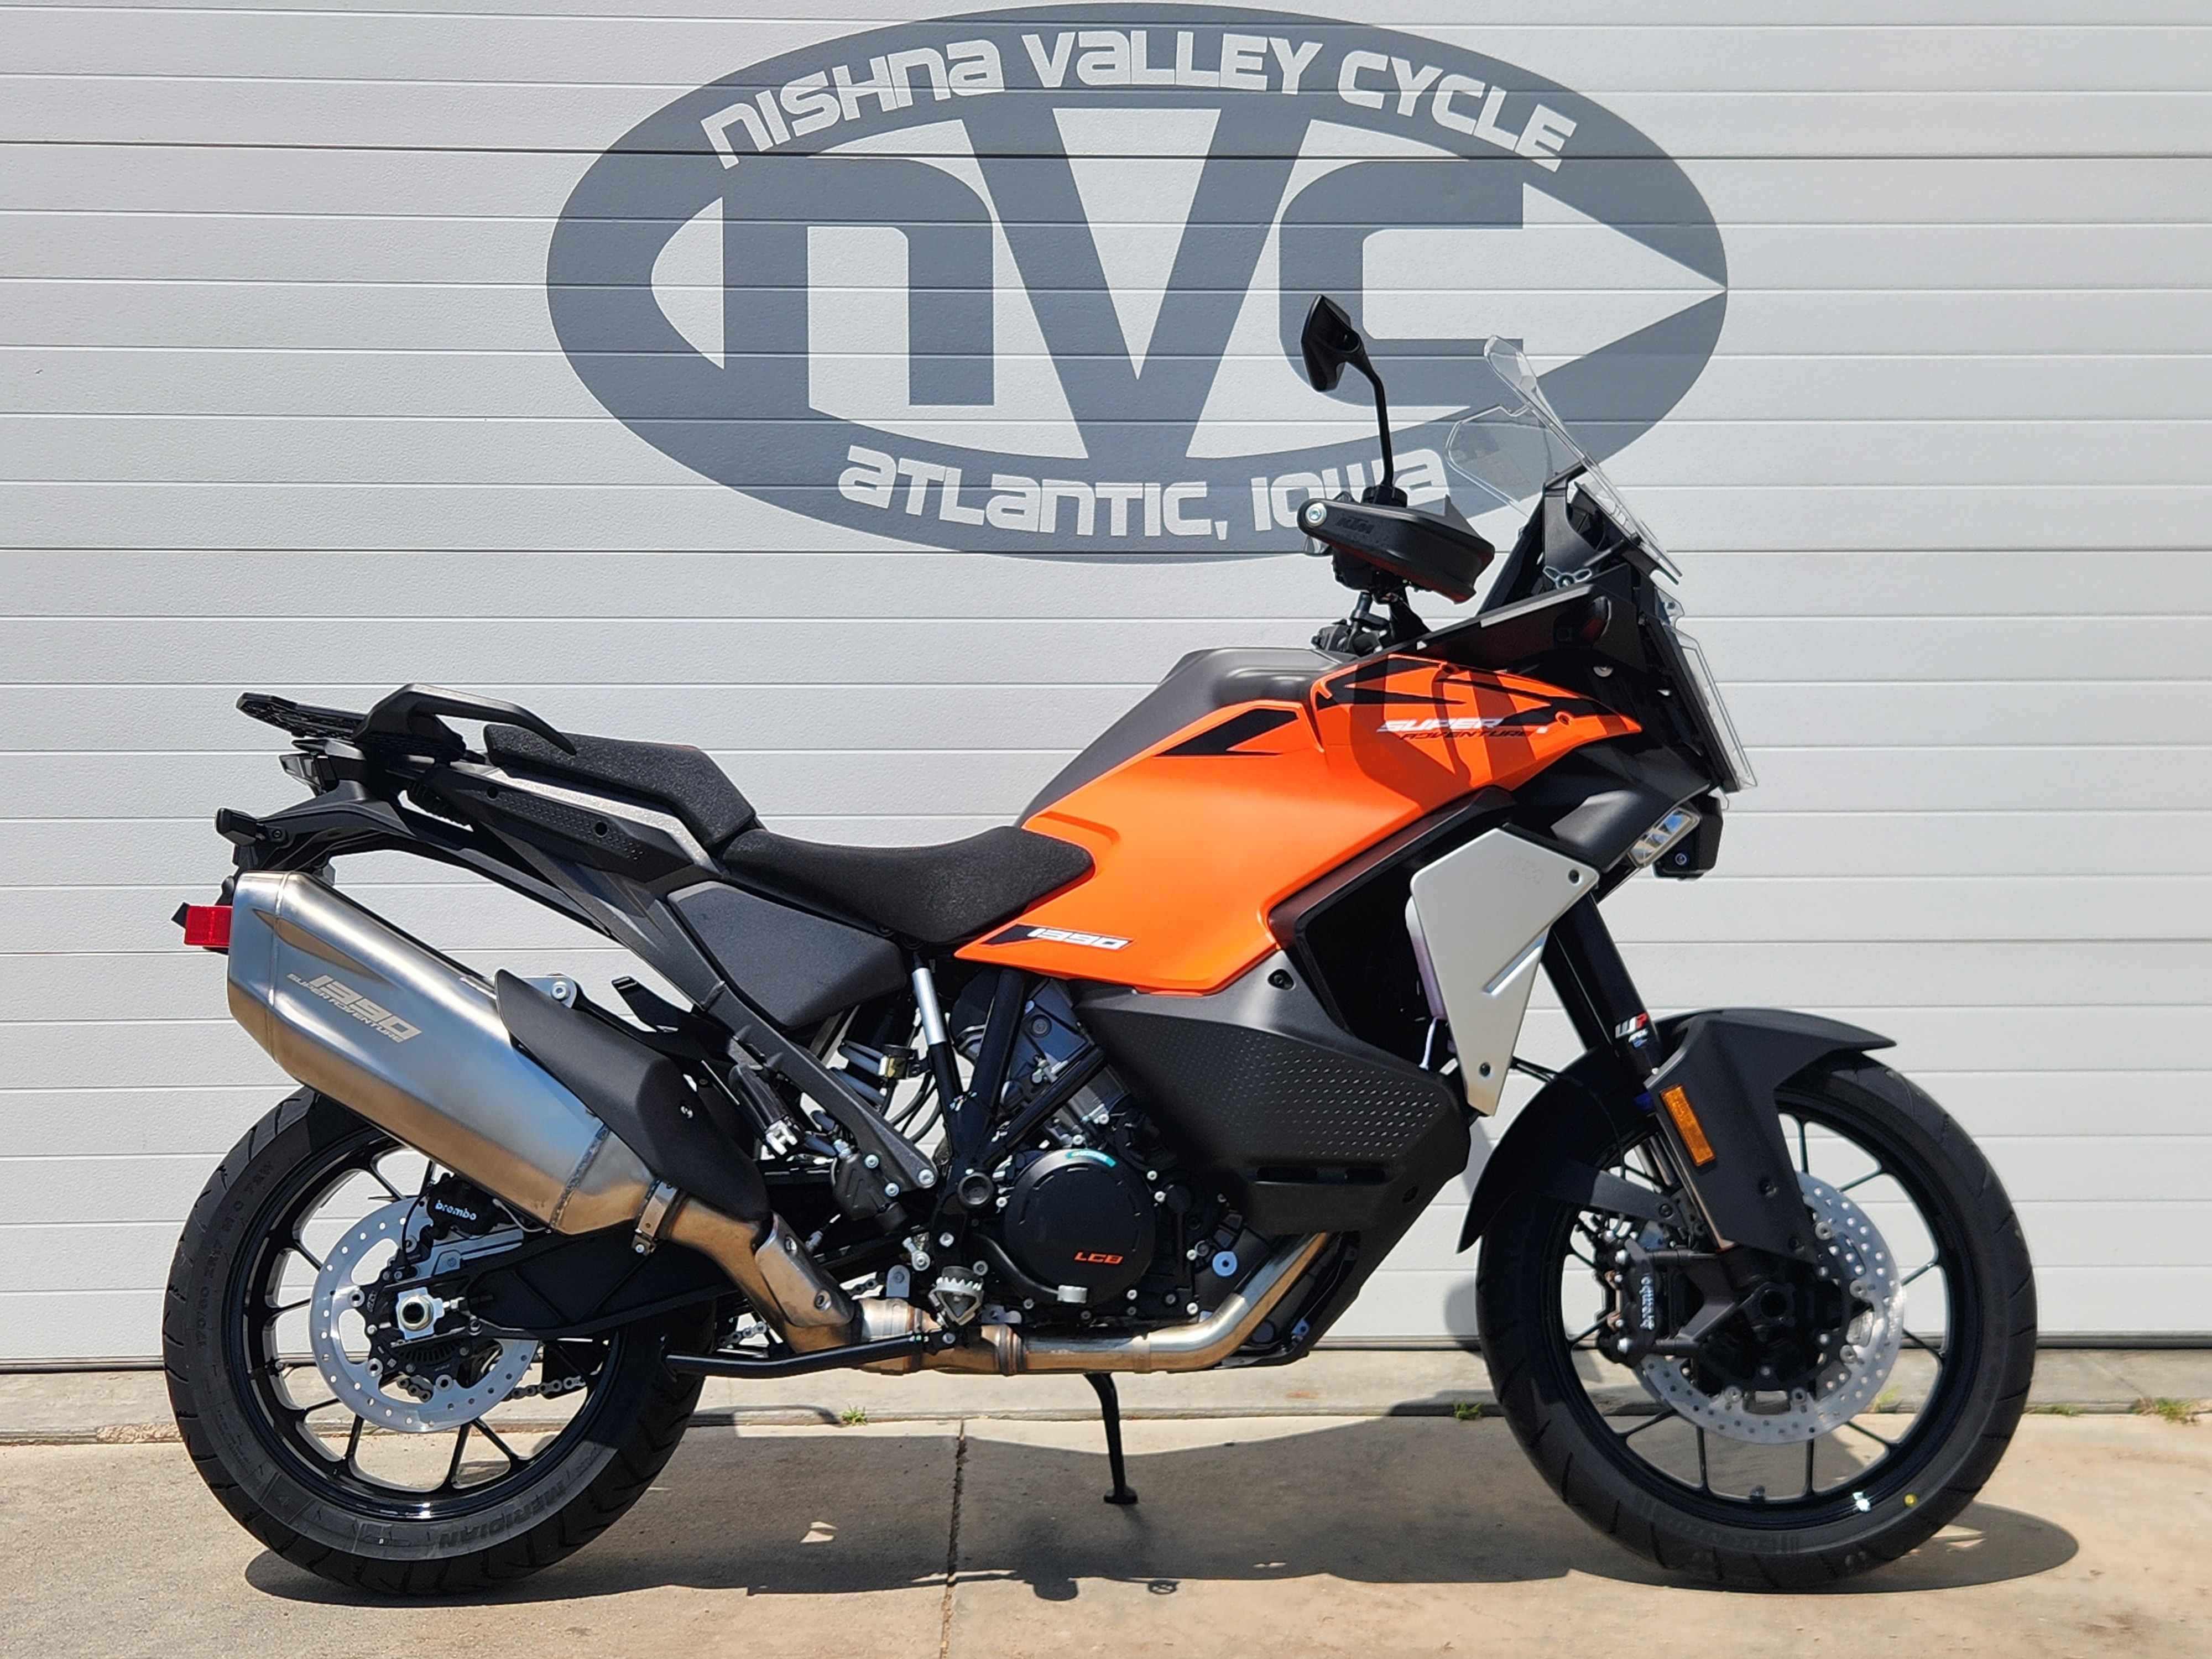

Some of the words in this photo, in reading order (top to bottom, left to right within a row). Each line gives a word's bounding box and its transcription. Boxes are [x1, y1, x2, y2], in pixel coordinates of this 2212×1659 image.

[1338, 50, 1577, 173] CYCLE
[1377, 718, 1504, 732] SUPER
[1399, 730, 1527, 740] ADVENTURE
[1027, 928, 1129, 950] 1390
[287, 973, 331, 1000] SUPER
[328, 995, 406, 1043] ADVENTURE
[309, 974, 422, 1040] 1390
[435, 1199, 477, 1220] brembo
[1639, 1276, 1655, 1330] brembo
